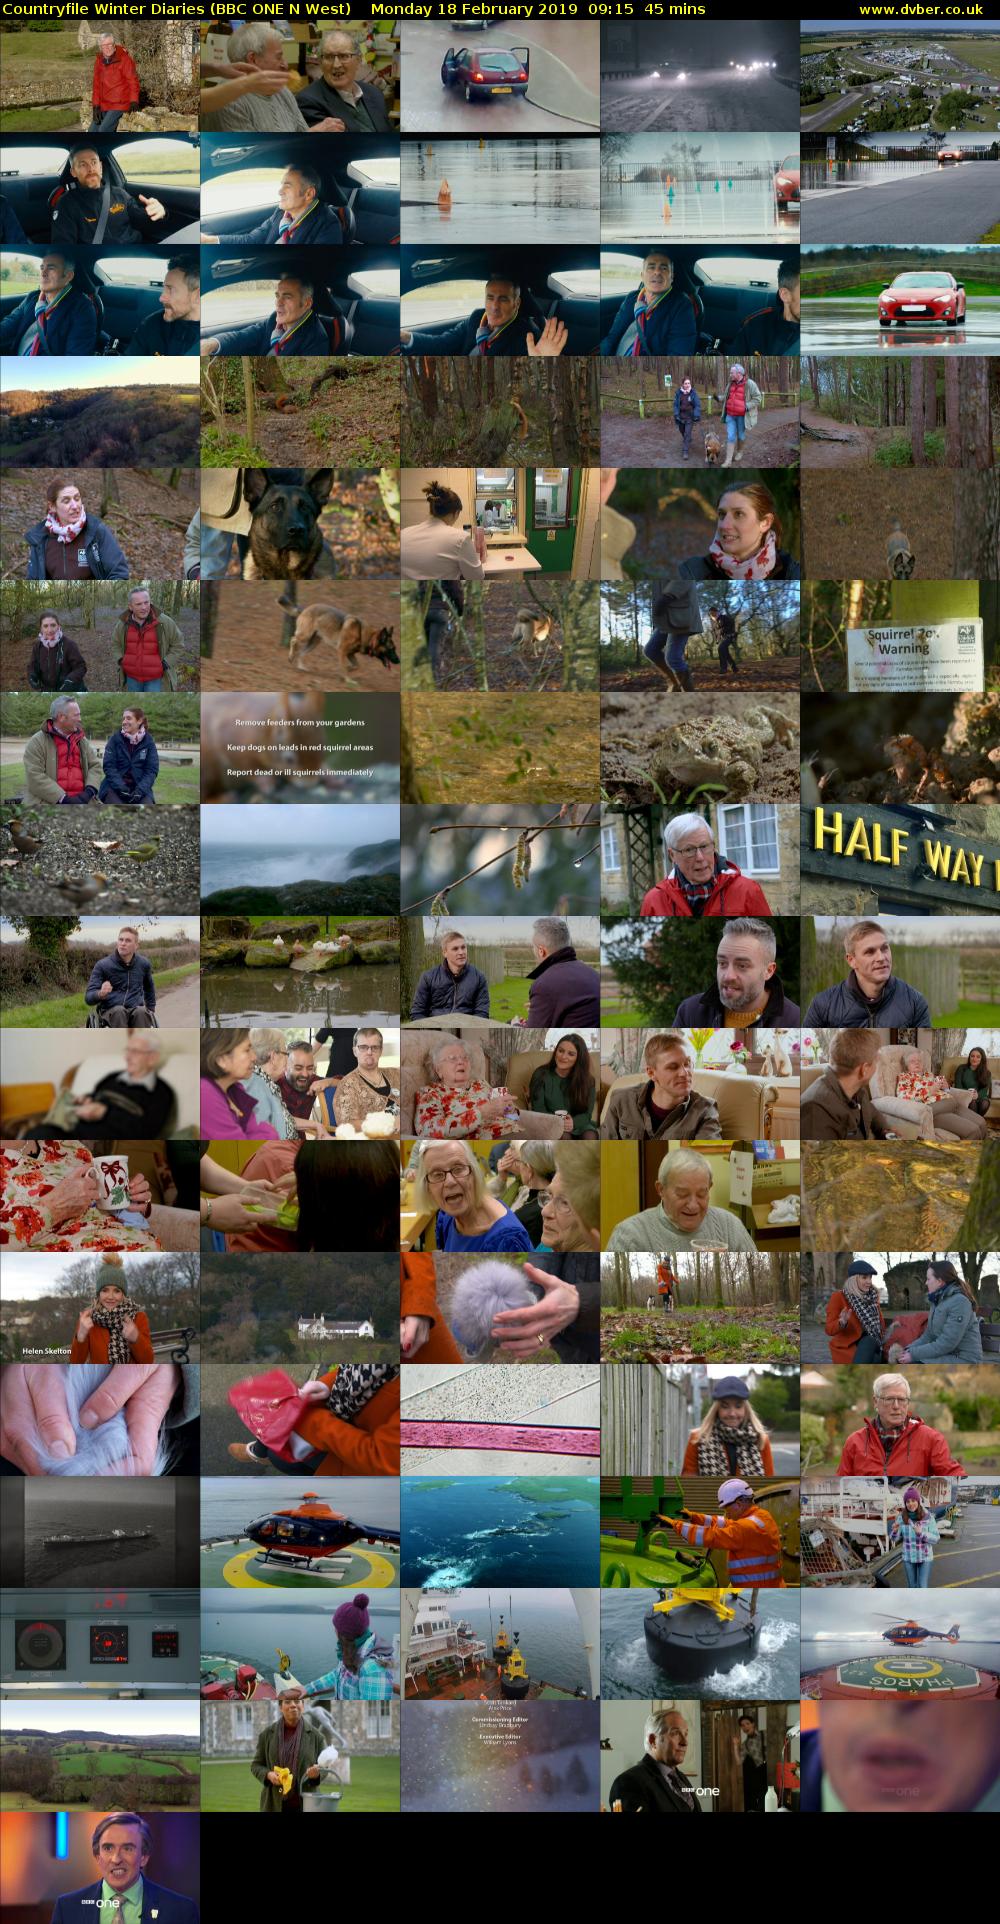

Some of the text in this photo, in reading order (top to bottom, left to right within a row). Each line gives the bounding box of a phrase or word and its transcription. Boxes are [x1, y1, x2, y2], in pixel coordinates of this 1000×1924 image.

[868, 628, 914, 642] Squirrel
[878, 643, 931, 656] Warning
[814, 806, 910, 867] HALF
[923, 838, 985, 887] WAY
[869, 1676, 955, 1688] PHAROS
